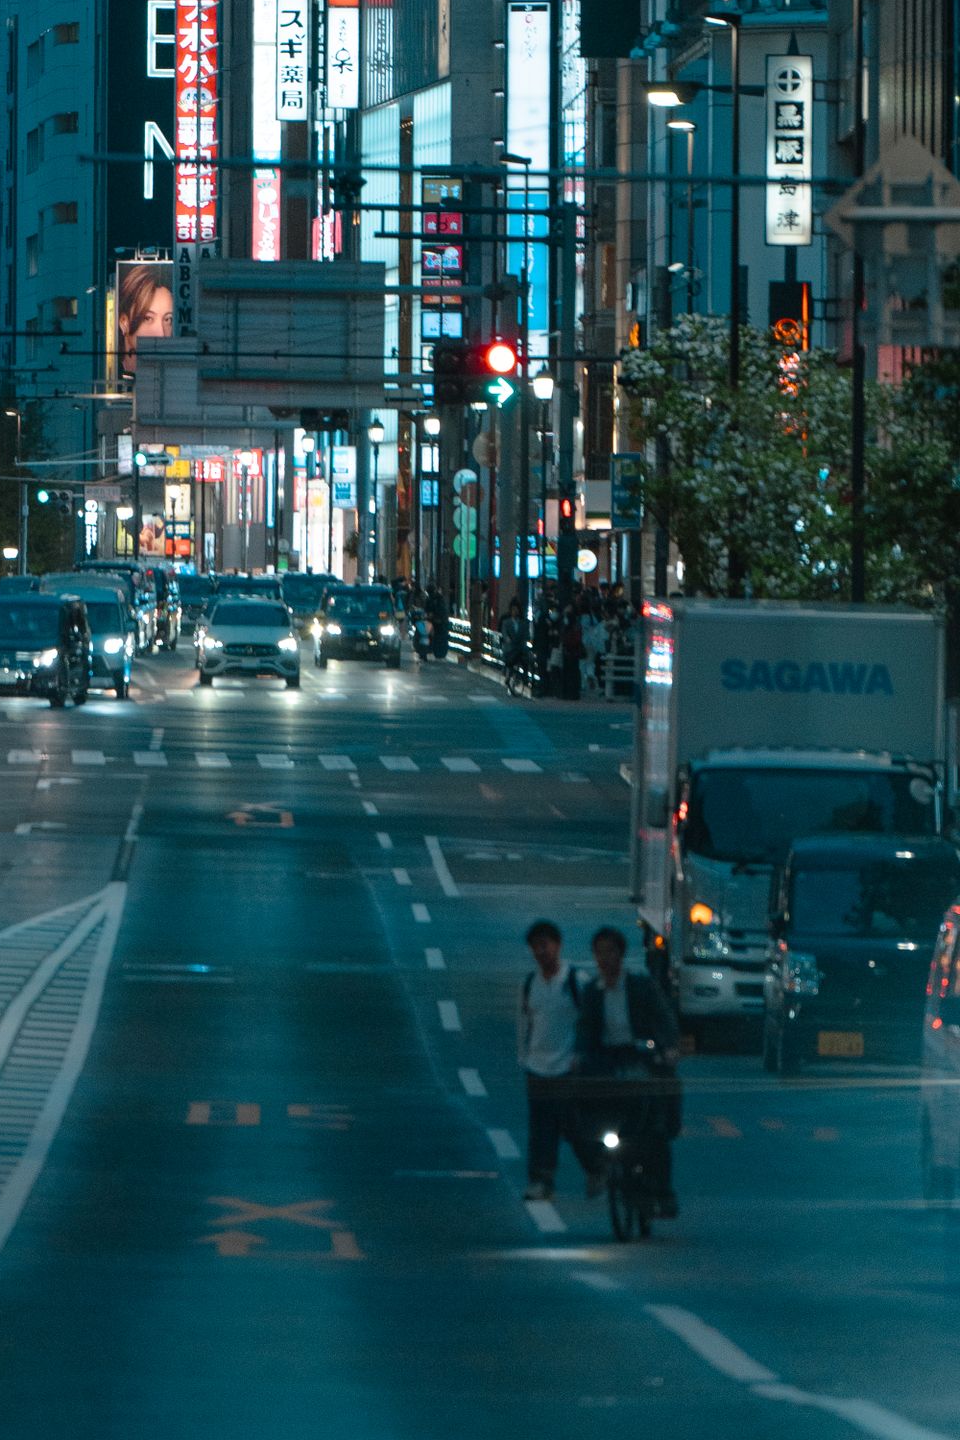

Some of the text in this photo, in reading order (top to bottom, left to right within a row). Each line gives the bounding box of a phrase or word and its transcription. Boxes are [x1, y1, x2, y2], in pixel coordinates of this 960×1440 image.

[279, 10, 306, 109] スギ薬局
[720, 659, 895, 696] SAGAWA
